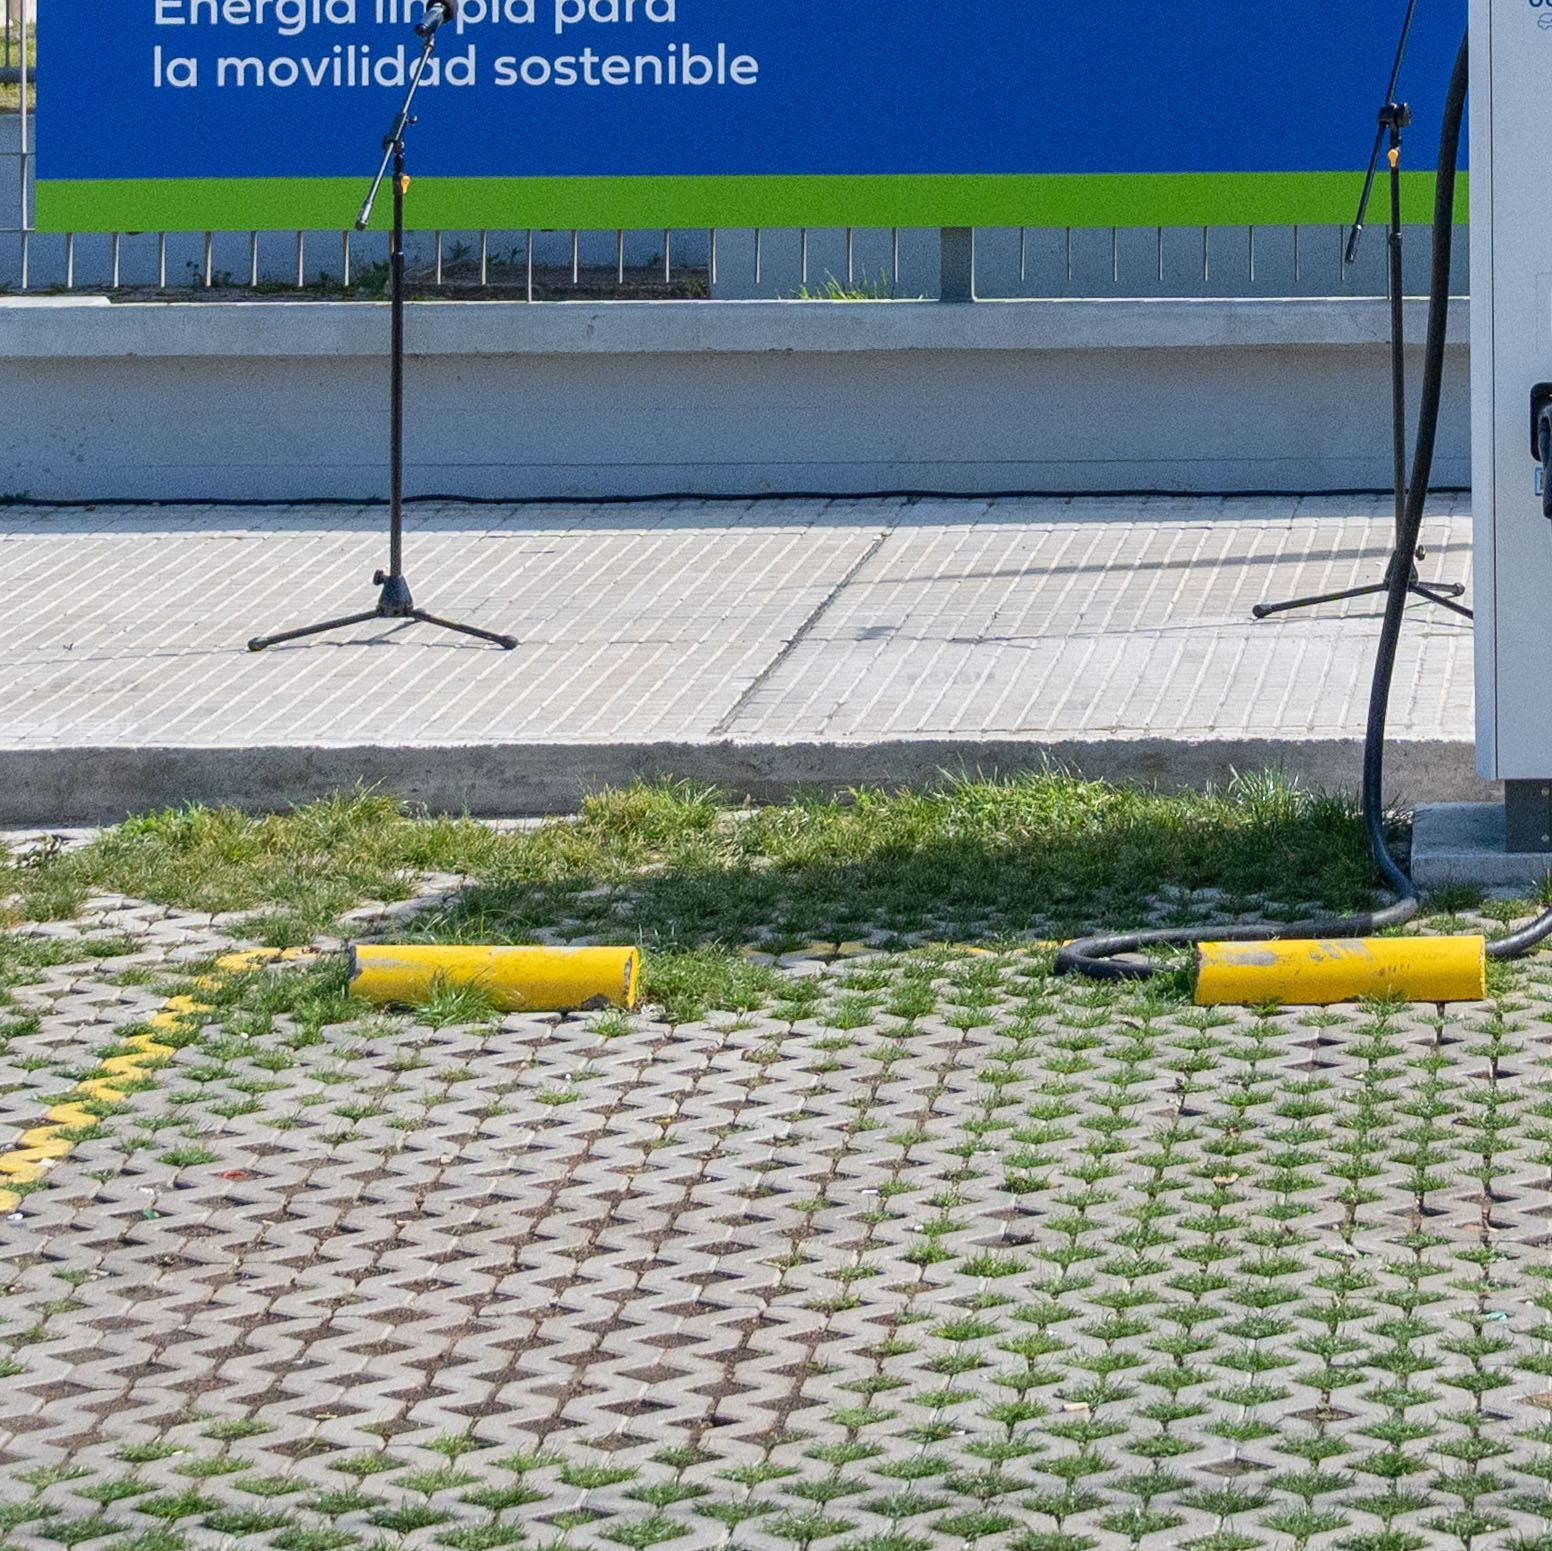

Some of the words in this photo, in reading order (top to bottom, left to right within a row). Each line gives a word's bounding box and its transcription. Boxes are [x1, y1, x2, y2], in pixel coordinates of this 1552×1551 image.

[154, 46, 199, 89] la
[217, 45, 477, 88] movilidad
[494, 43, 760, 87] sostenible
